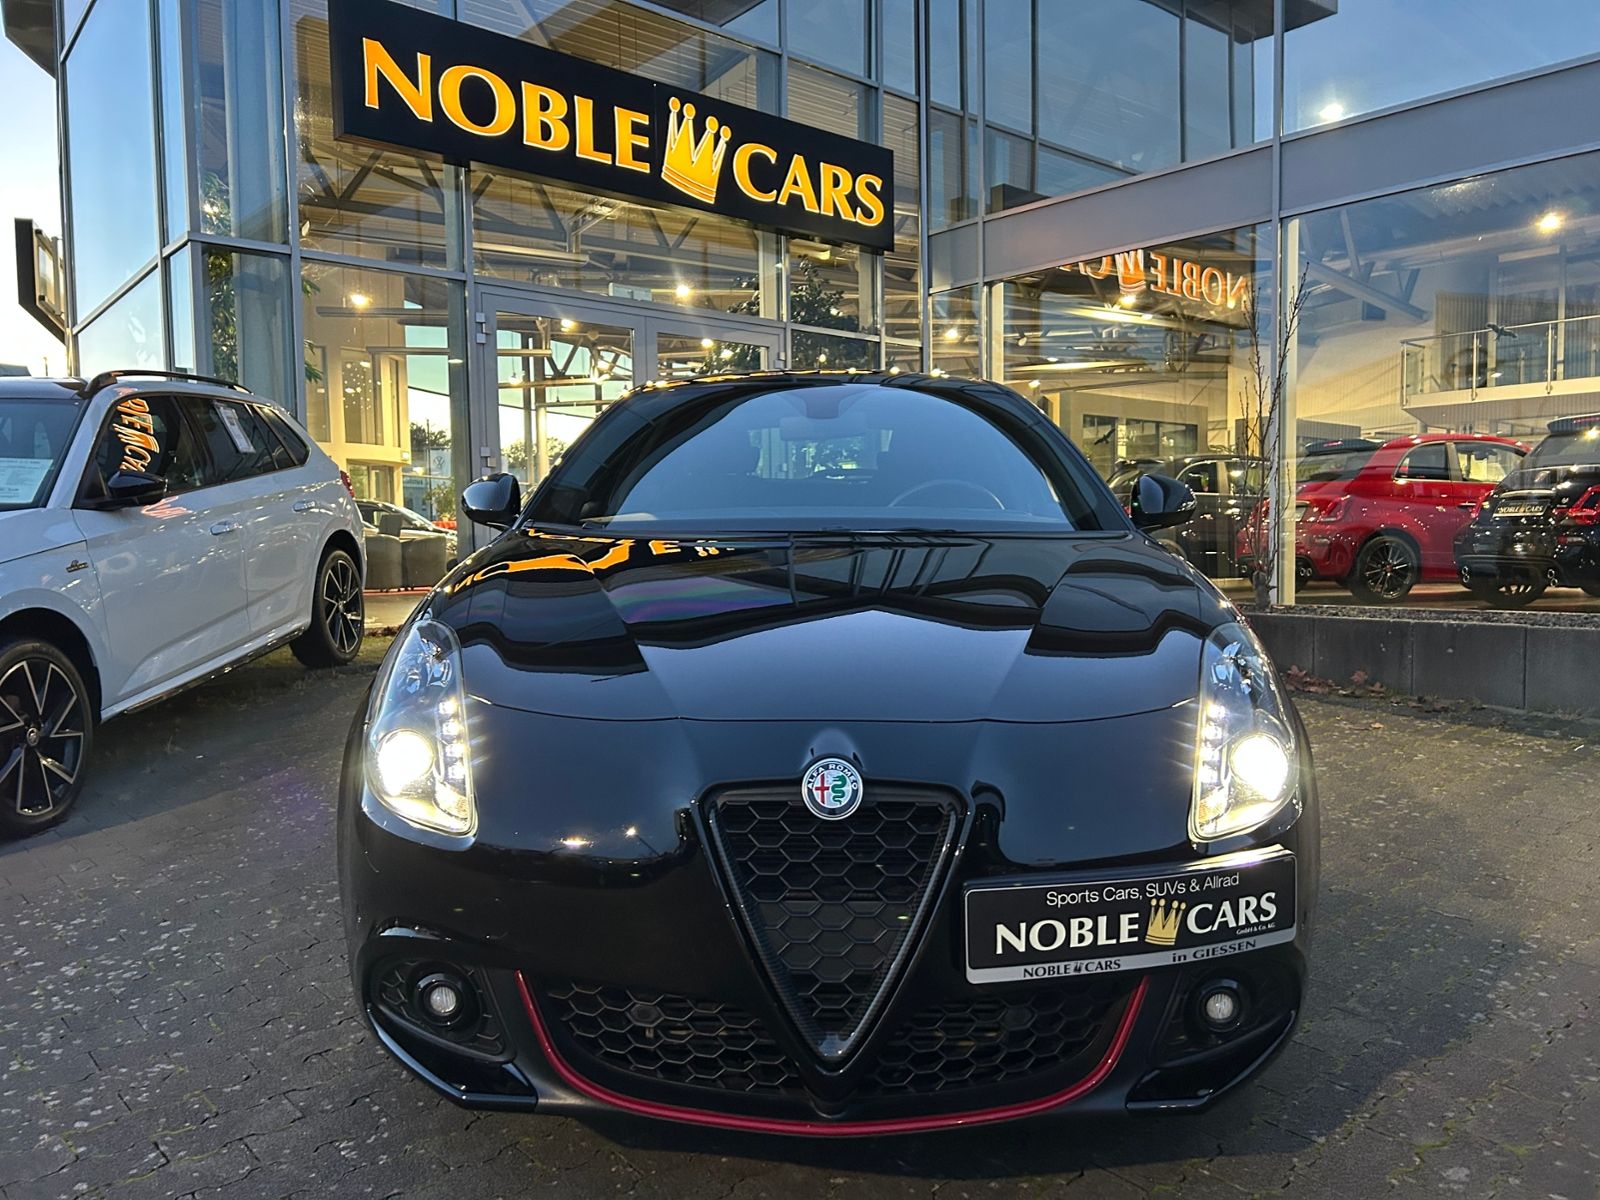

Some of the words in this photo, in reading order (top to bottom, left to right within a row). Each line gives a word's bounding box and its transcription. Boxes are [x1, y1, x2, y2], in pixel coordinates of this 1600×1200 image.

[362, 37, 650, 174] NOBLE
[733, 143, 884, 226] CARS
[807, 766, 825, 790] ALFA
[828, 763, 858, 790] ROMEO
[1046, 889, 1099, 908] Sports
[1102, 886, 1142, 902] Cars,
[1145, 881, 1186, 898] SUVs
[1189, 878, 1201, 893] &
[1203, 872, 1240, 891] Allrad
[995, 912, 1140, 955] NOBLE
[1186, 891, 1277, 934] CARS
[1172, 952, 1187, 963] in
[1192, 939, 1257, 960] GIESSEN
[1023, 961, 1071, 978] NOBLE
[1084, 959, 1121, 973] CARS
